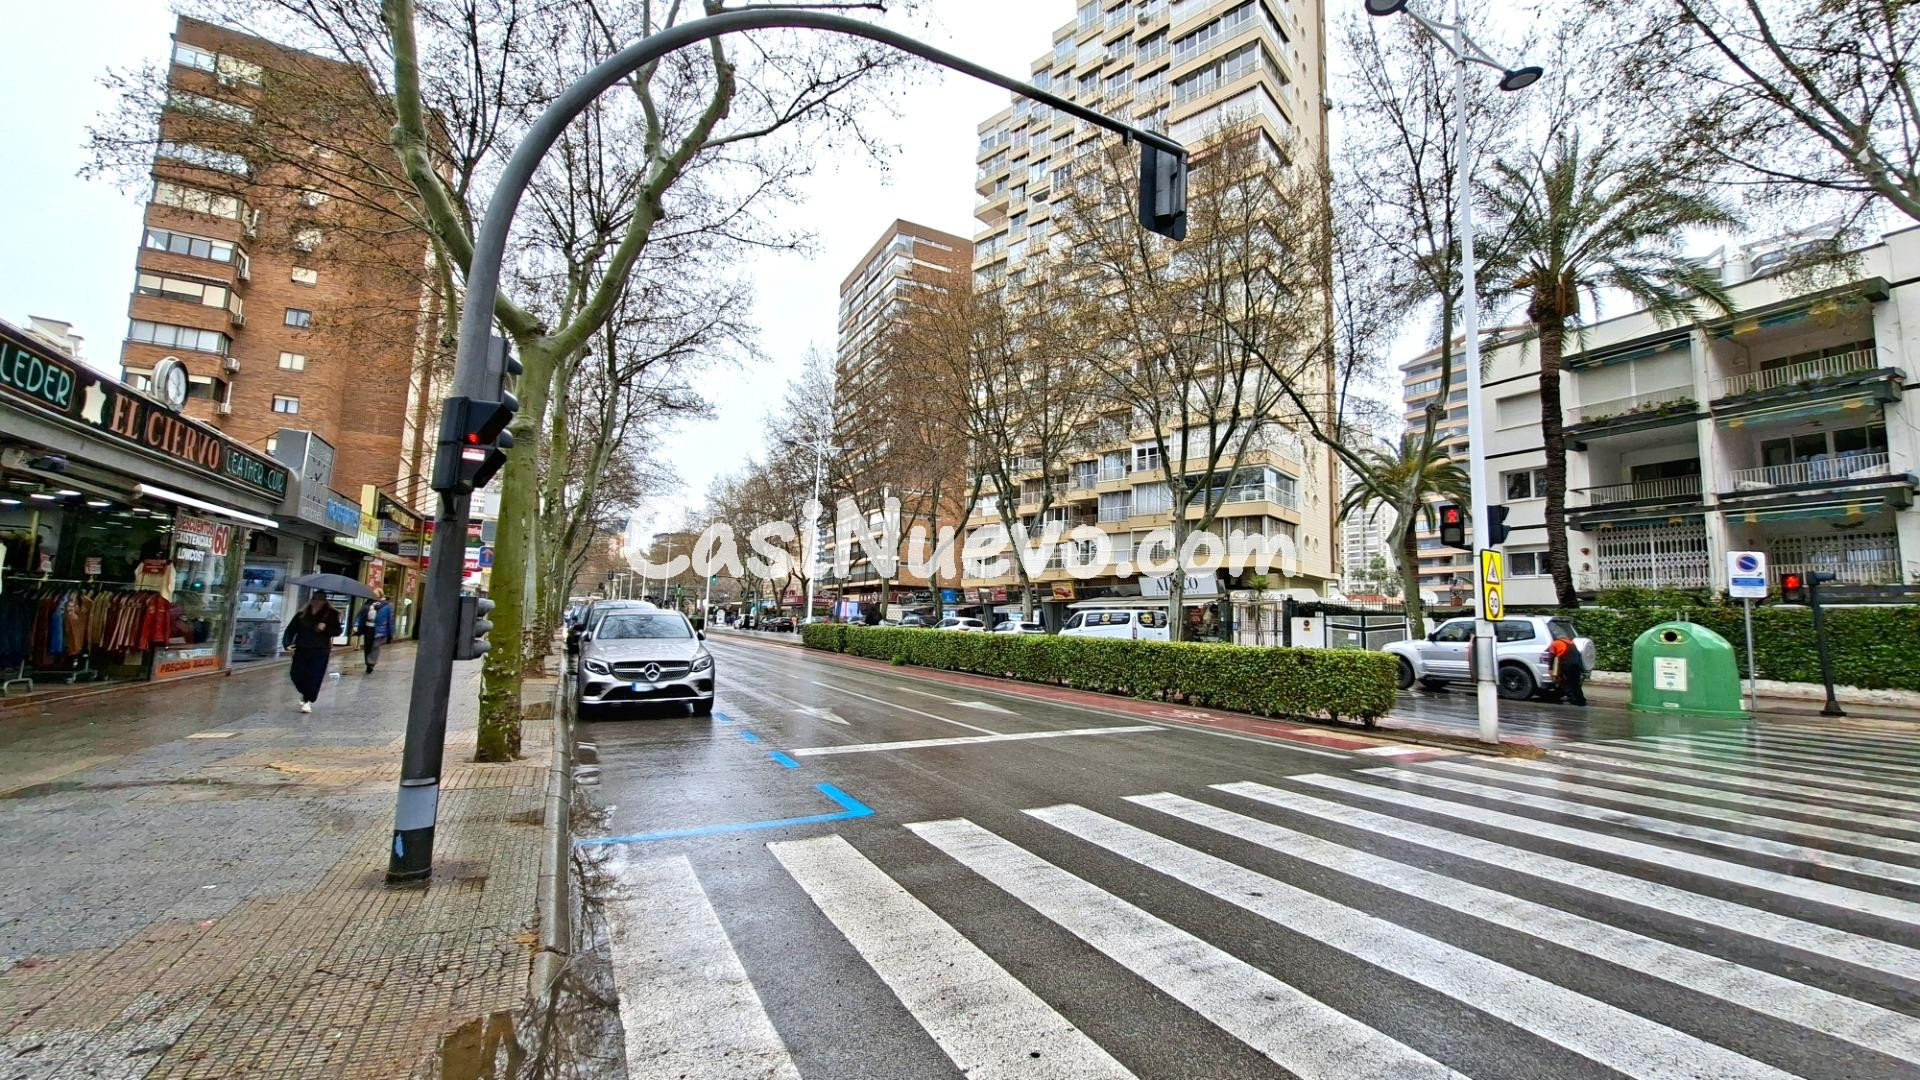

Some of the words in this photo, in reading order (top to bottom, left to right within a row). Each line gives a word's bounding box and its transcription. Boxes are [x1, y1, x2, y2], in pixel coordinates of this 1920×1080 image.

[0, 343, 70, 406] LEDER
[110, 392, 140, 440] EL
[147, 411, 220, 470] CIERVO
[226, 450, 264, 485] LEATHER
[214, 525, 229, 555] 60
